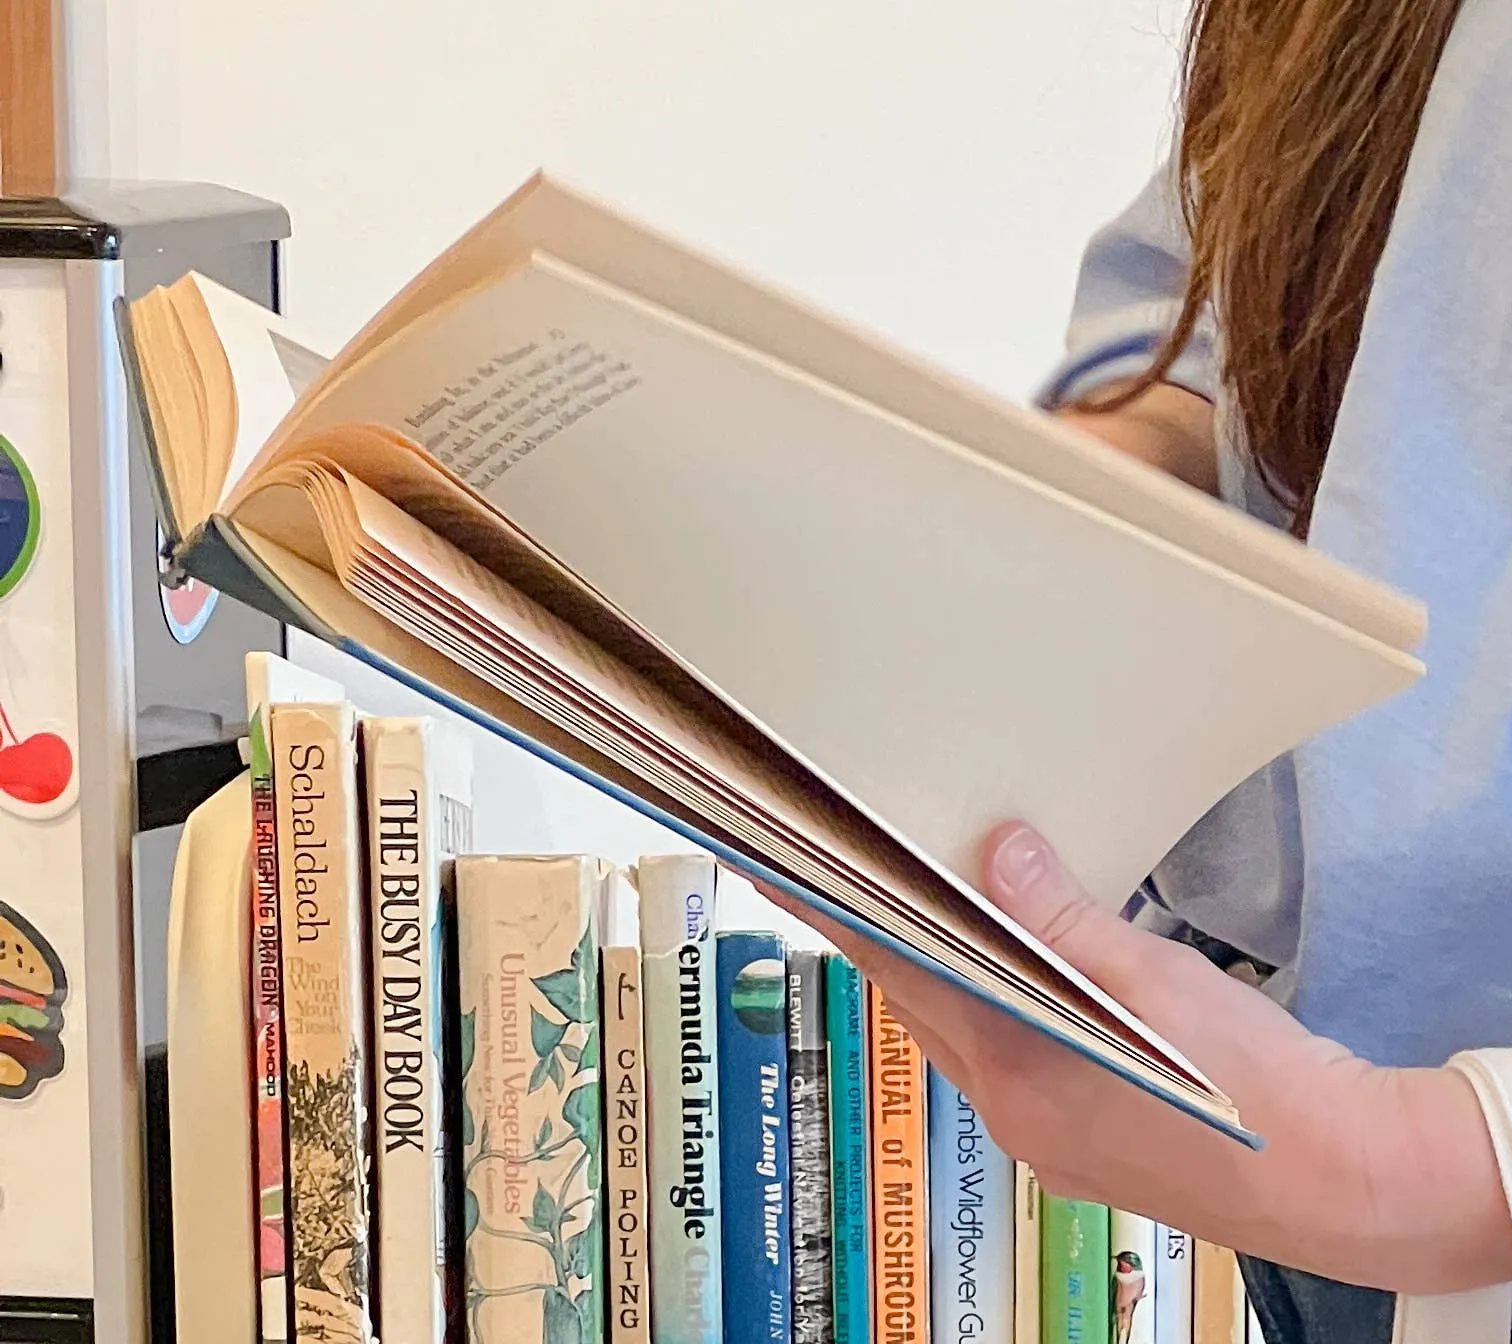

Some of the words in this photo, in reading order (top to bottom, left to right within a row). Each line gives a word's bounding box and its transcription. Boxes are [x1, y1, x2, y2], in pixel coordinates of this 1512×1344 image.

[288, 744, 331, 944] Schaldach
[379, 789, 419, 866] THE
[381, 873, 421, 968] BUSY
[383, 976, 423, 1042] DAY
[499, 952, 526, 1064] Unusual
[789, 974, 803, 1052] BLEWITT
[265, 1022, 276, 1097] MAHOOD
[760, 1062, 780, 1109] The
[384, 1051, 424, 1154] BOOK
[497, 1071, 528, 1215] Vegetables
[616, 1049, 638, 1169] CANOE
[755, 1114, 782, 1177] Long
[617, 1189, 640, 1329] POLING
[762, 1182, 783, 1265] Winter
[769, 1290, 783, 1340] JOHN
